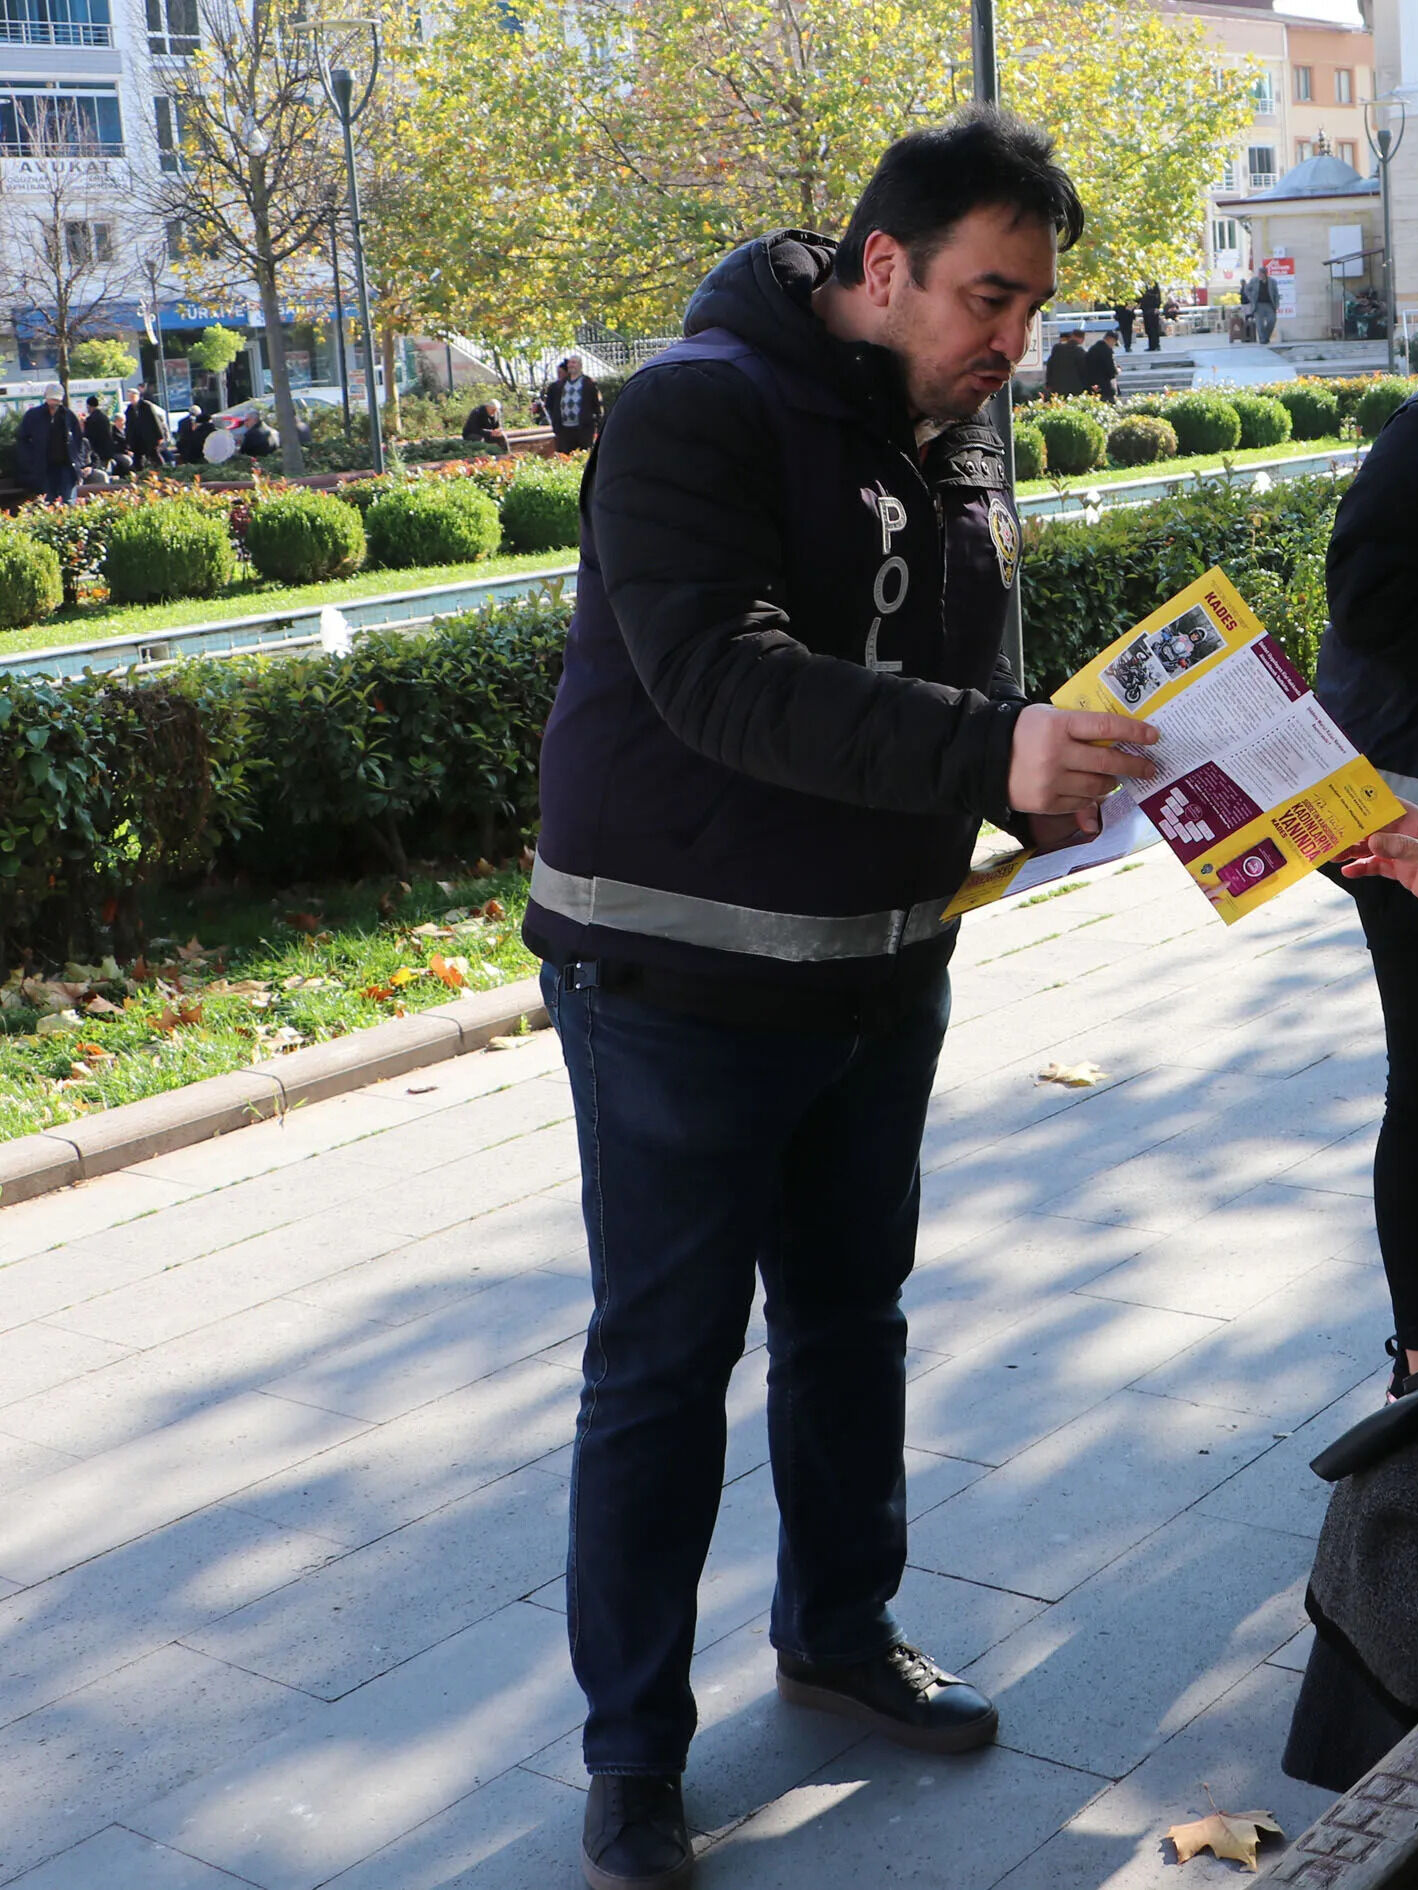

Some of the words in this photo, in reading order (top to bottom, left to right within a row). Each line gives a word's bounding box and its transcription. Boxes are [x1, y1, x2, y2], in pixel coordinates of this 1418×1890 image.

[19, 160, 111, 173] AVUKAT
[1203, 590, 1238, 632] KADES
[1269, 817, 1288, 839] KADES
[1276, 808, 1322, 863] YANINDA
[1289, 800, 1334, 854] KADINLARIN
